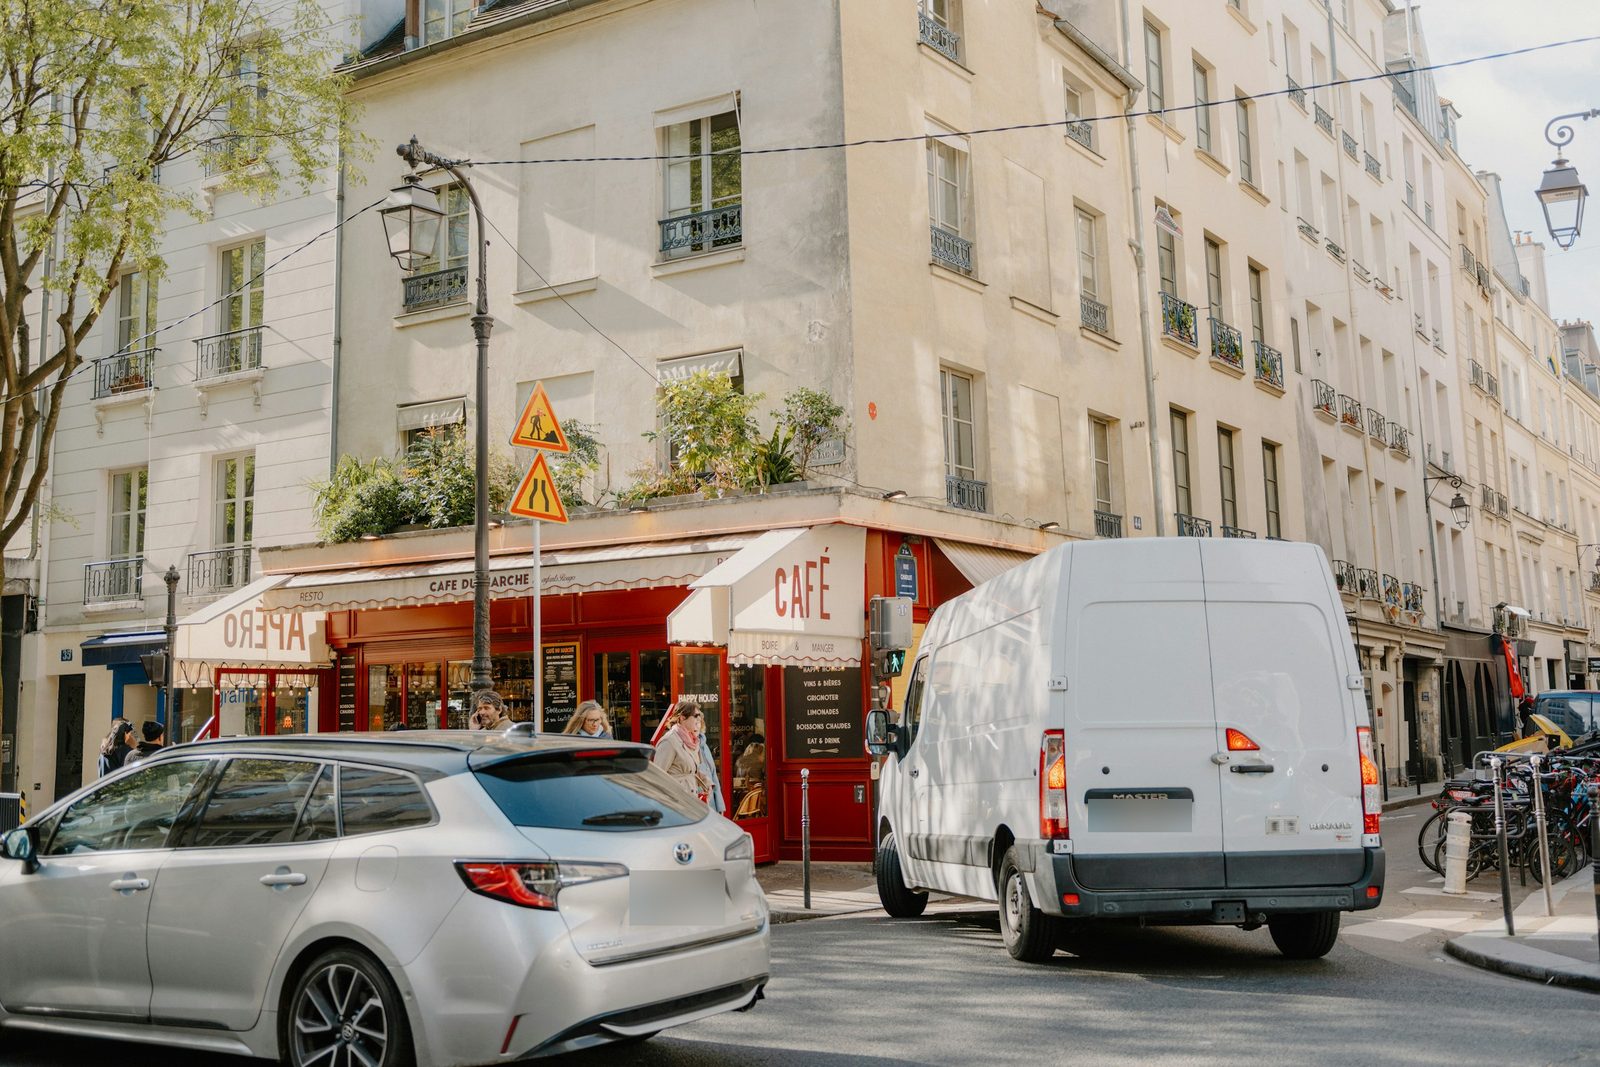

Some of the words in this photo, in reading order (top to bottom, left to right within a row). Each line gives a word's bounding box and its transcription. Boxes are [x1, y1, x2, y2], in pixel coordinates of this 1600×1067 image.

[429, 580, 457, 592] CAFE
[489, 573, 529, 588] ARCHE
[775, 547, 830, 620] CAFÉ
[300, 591, 324, 602] RESTO
[761, 640, 778, 650] BOIRE
[795, 641, 799, 651] &
[812, 643, 834, 653] MANGER
[678, 694, 698, 703] HAPPY
[699, 694, 719, 703] HOURS
